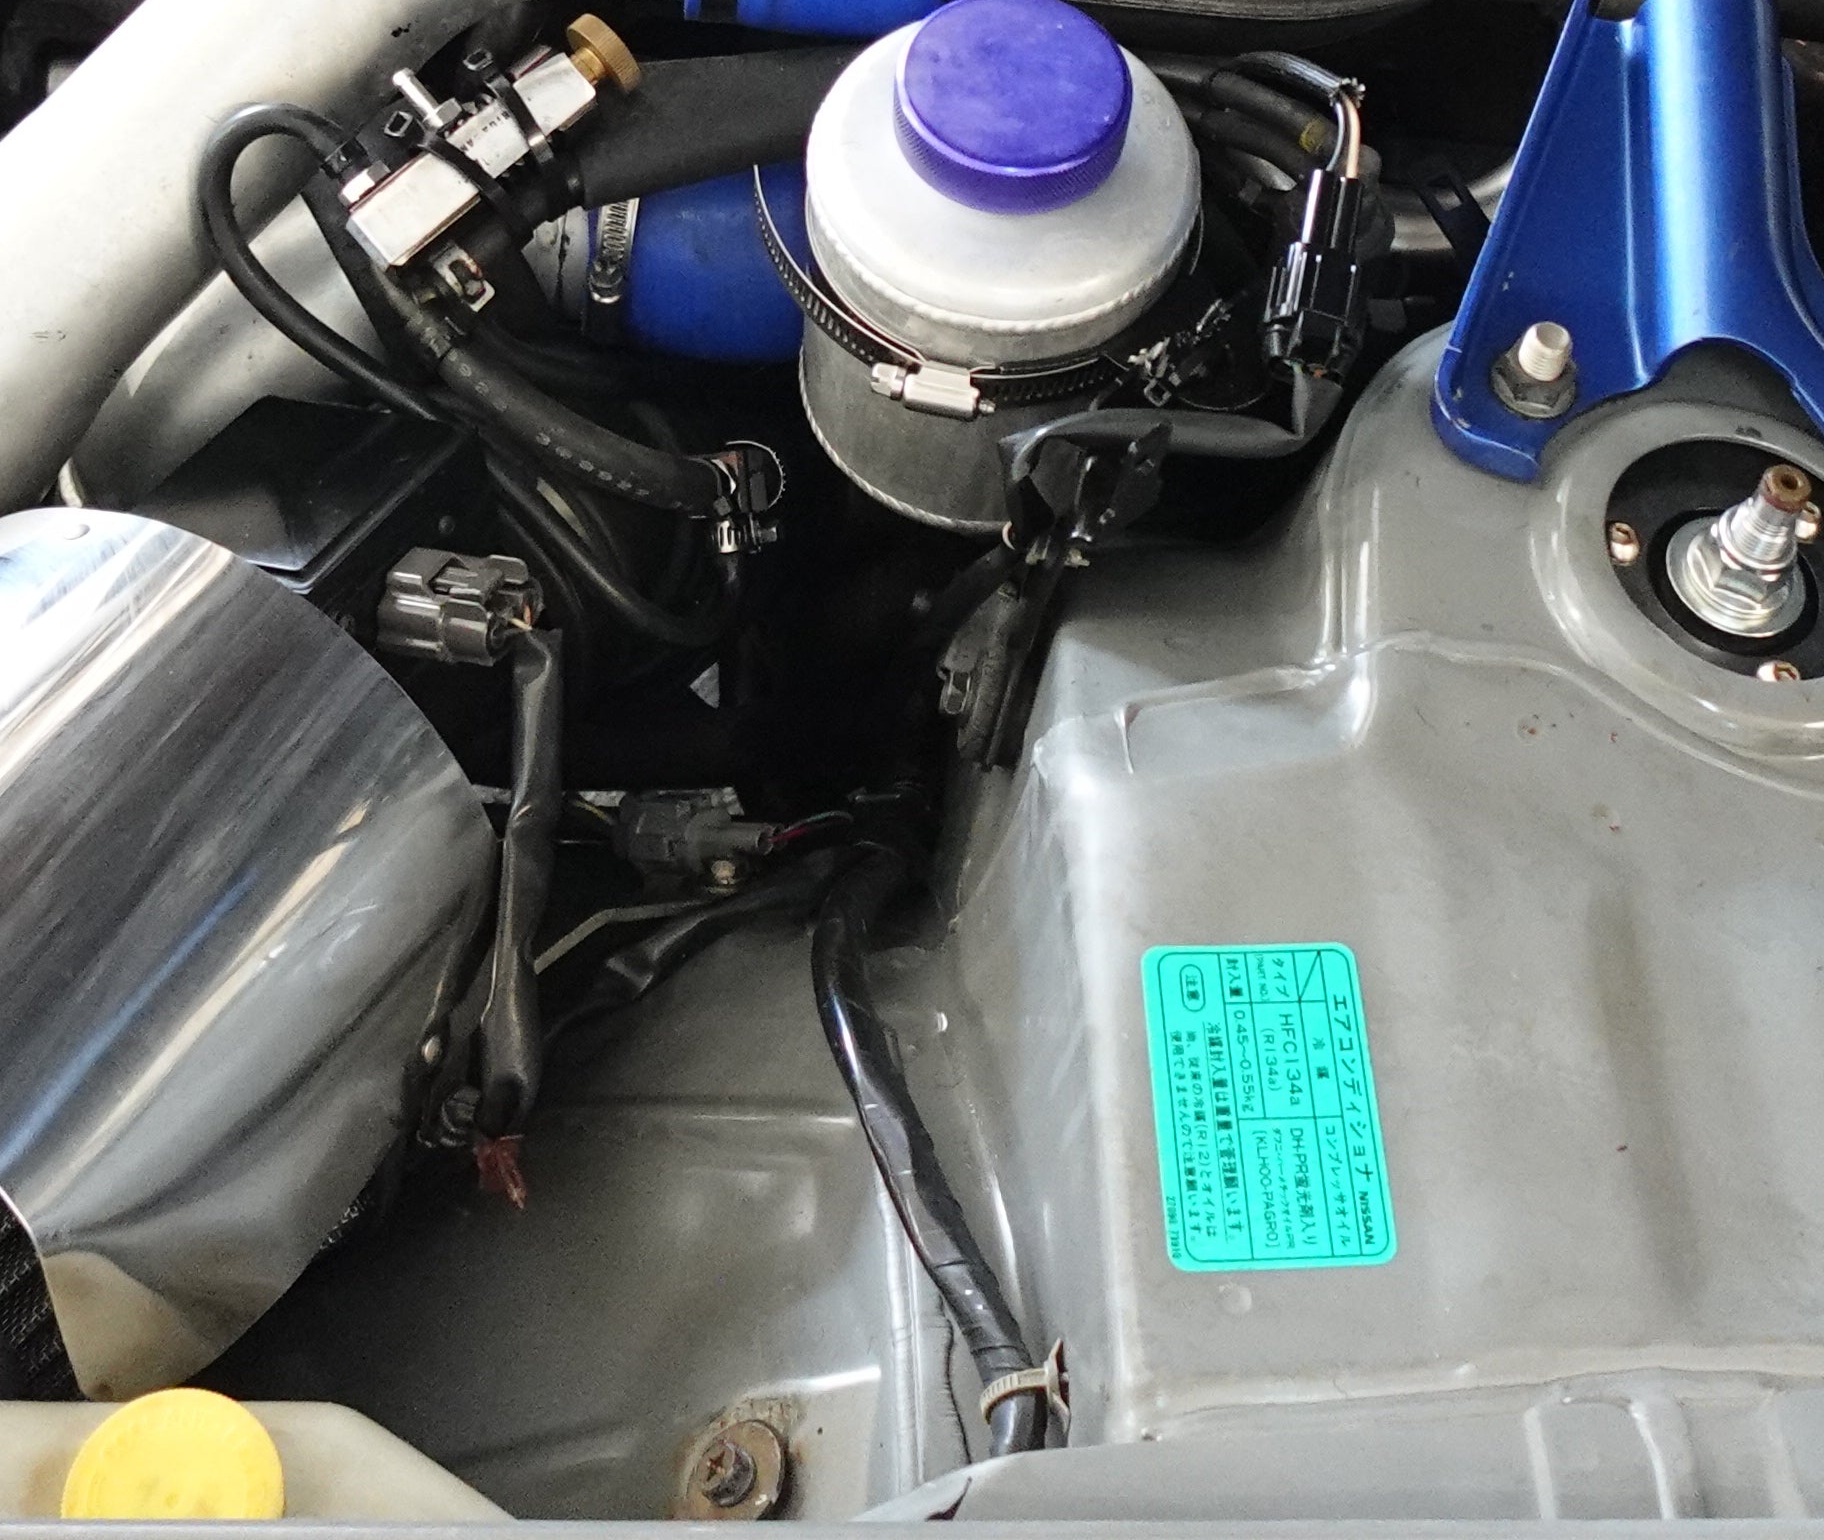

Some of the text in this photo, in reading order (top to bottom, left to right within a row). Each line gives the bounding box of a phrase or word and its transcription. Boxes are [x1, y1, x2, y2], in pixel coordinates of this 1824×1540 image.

[1259, 1027, 1282, 1091] (R134a)
[1278, 1013, 1303, 1106] HFC134a
[1332, 992, 1375, 1245] エアコンディショナ NISSAN
